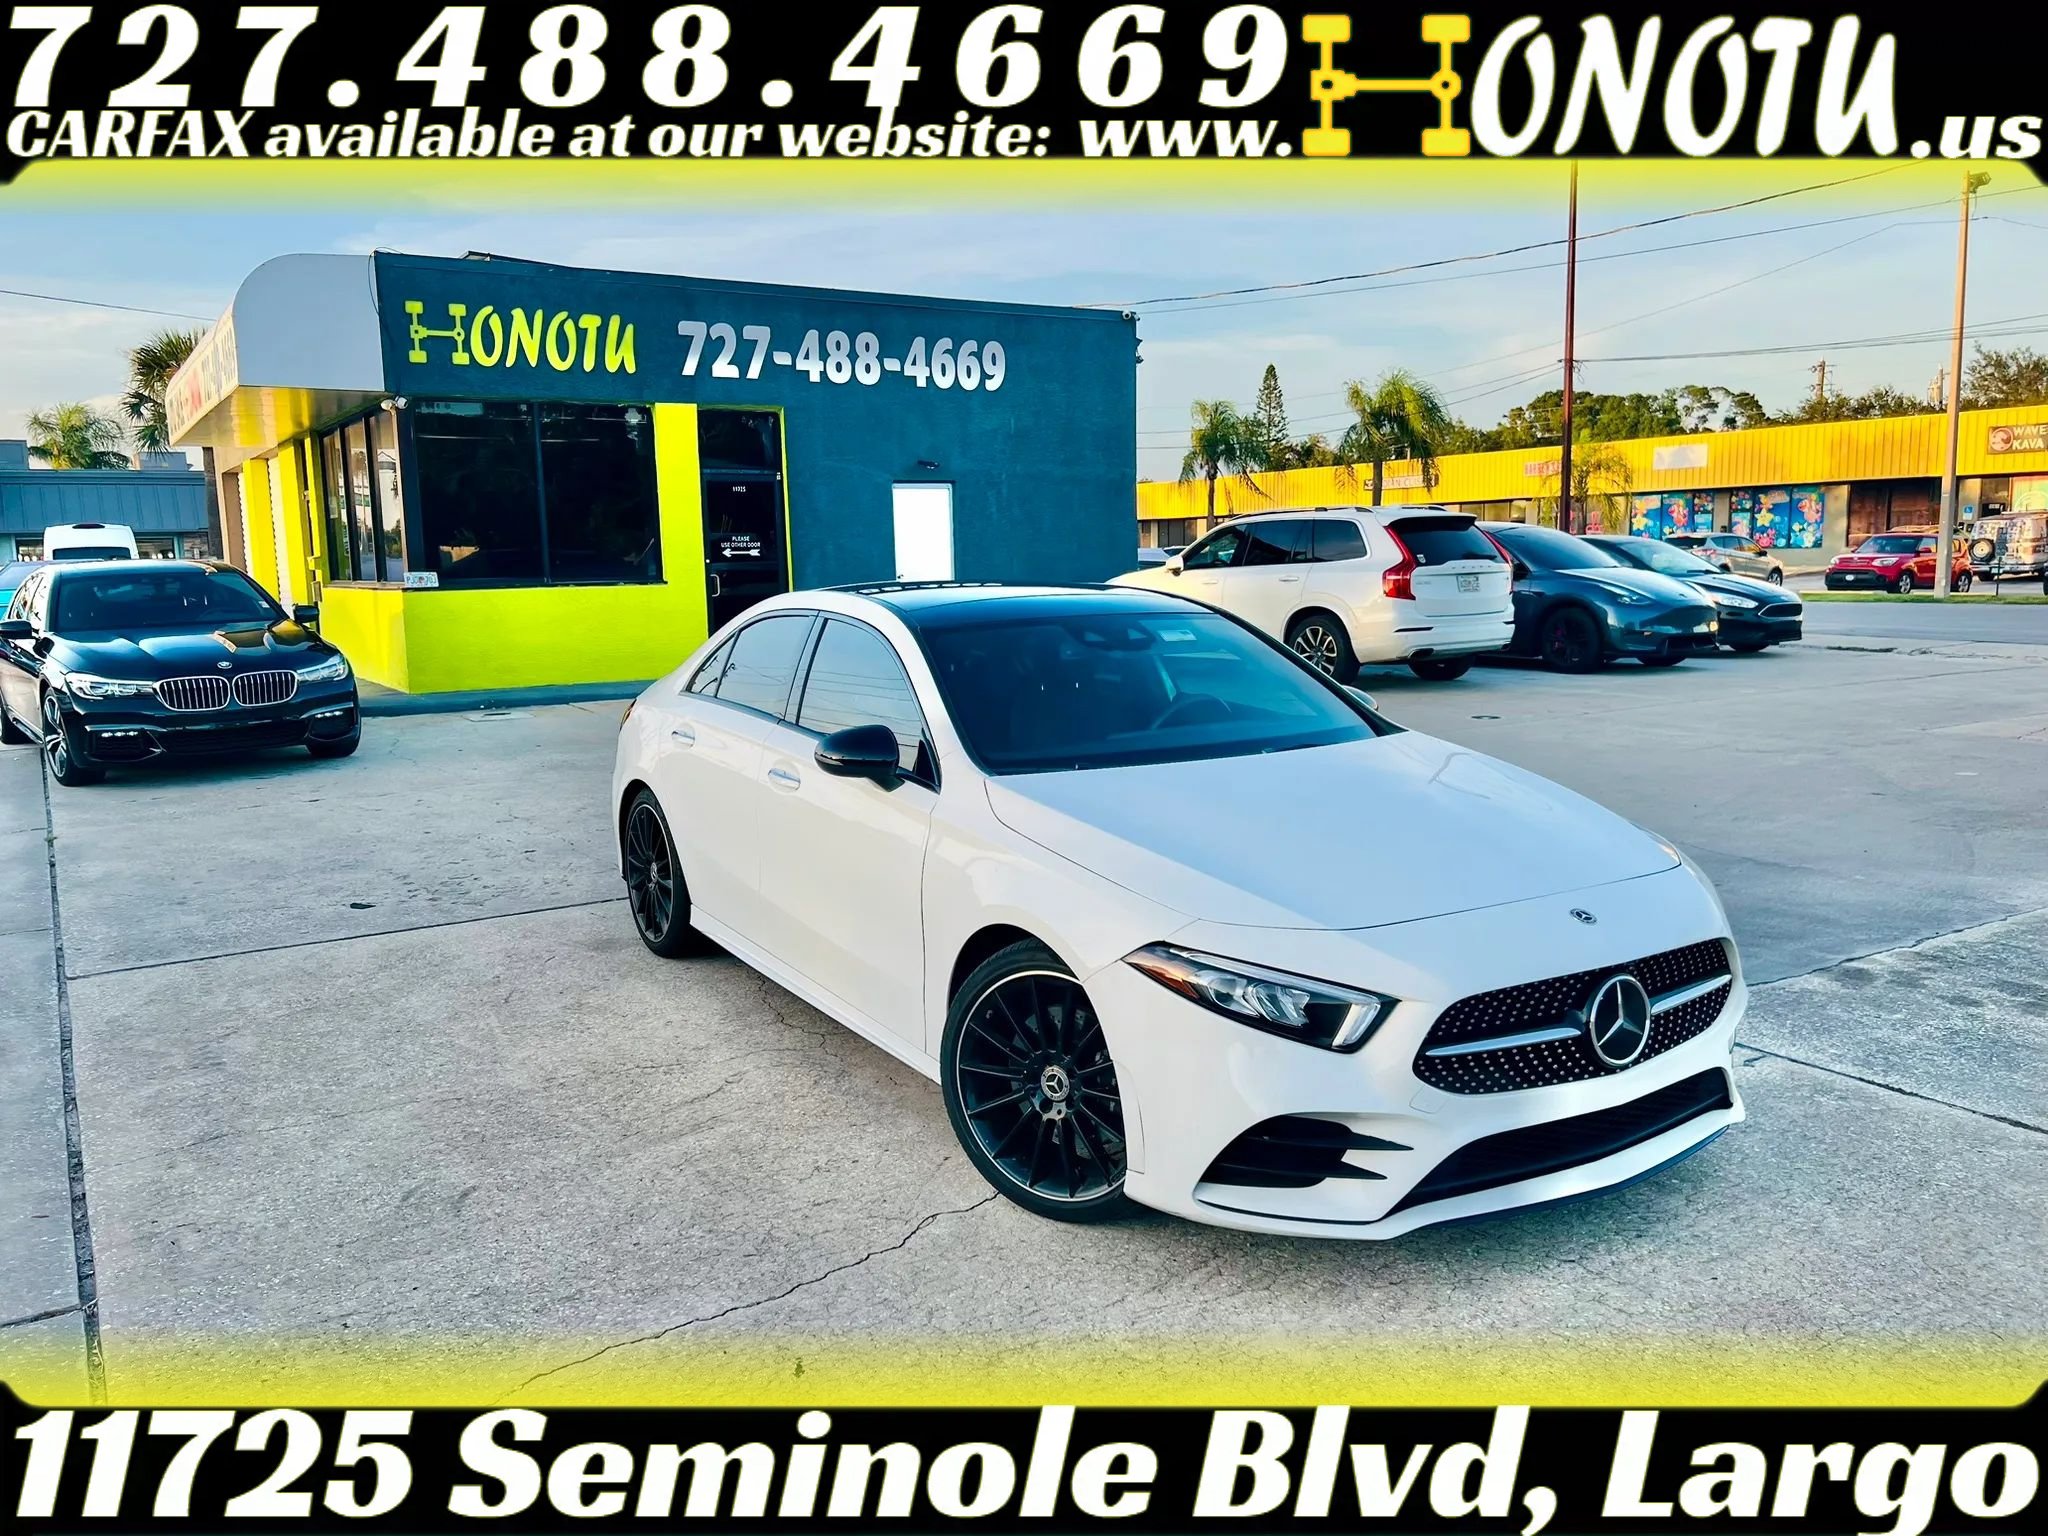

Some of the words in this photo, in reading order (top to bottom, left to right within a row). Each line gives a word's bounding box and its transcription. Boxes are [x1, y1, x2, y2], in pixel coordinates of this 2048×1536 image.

[677, 320, 1007, 392] 727-488-4669
[2013, 425, 2048, 437] WAVE
[2012, 438, 2045, 450] KAVA
